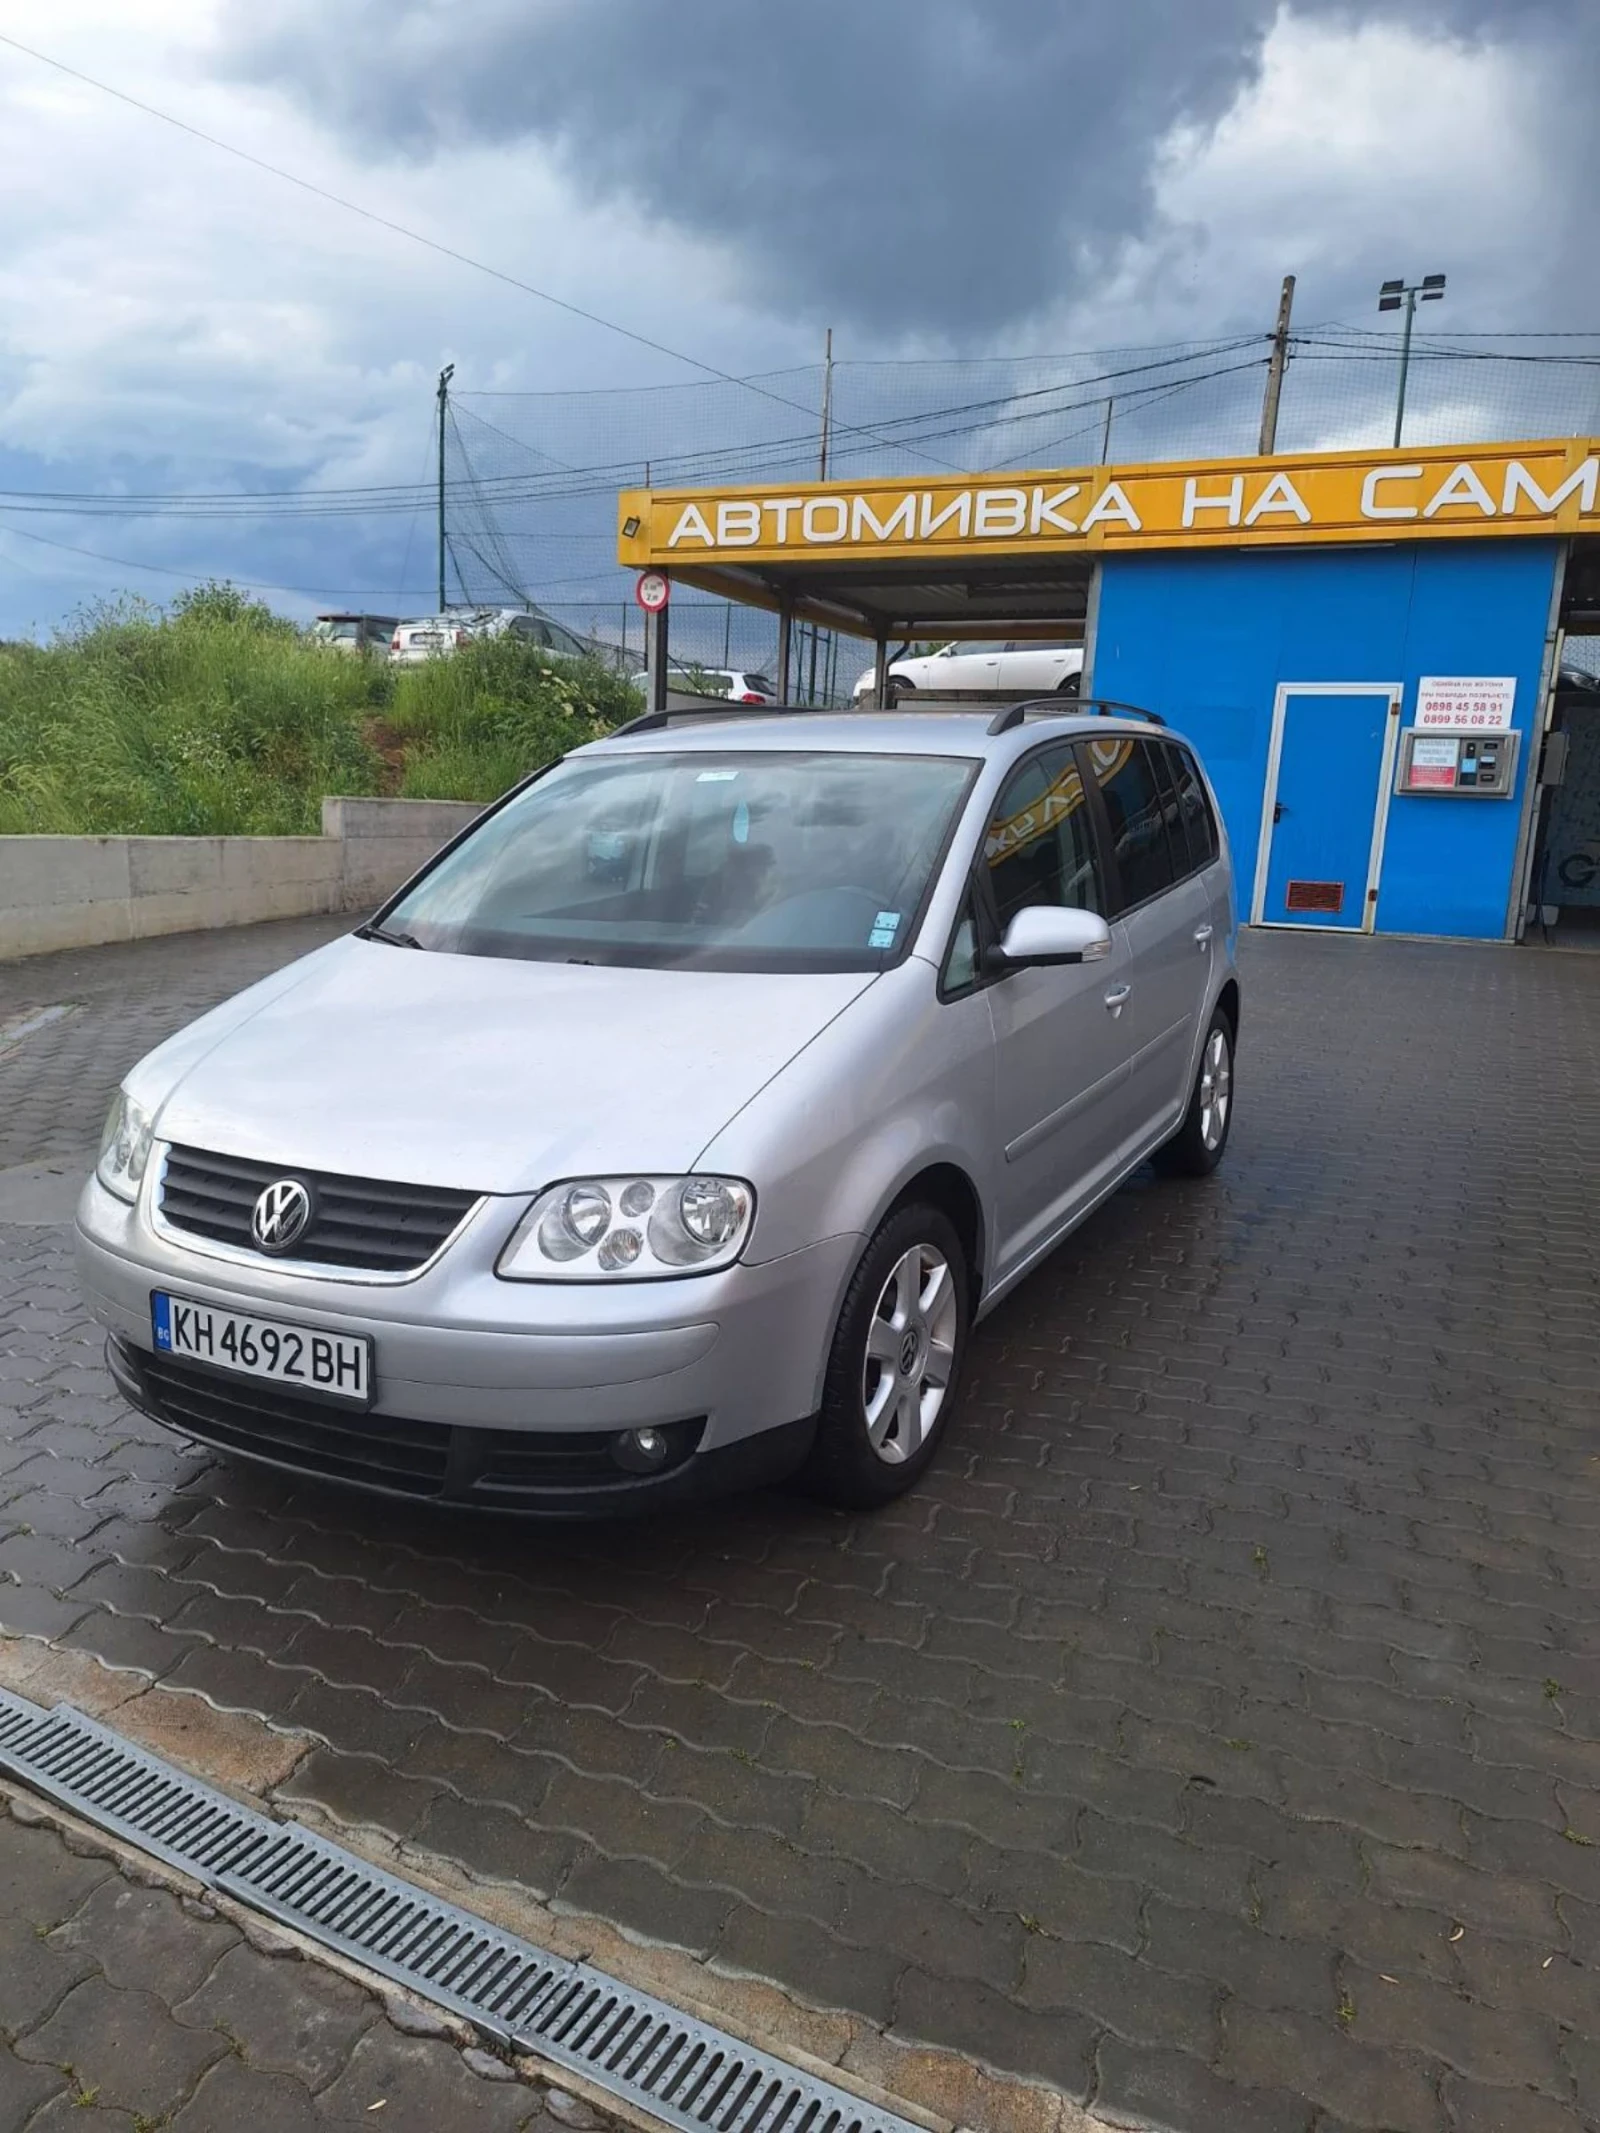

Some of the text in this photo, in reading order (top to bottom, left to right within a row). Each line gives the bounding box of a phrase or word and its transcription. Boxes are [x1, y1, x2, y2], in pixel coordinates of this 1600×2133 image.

[667, 457, 1600, 548] АВТОМИВКА НА САМ
[1425, 702, 1503, 712] 0898 45 58 91
[1423, 714, 1502, 725] 0899 56 08 22
[157, 1328, 170, 1341] BG
